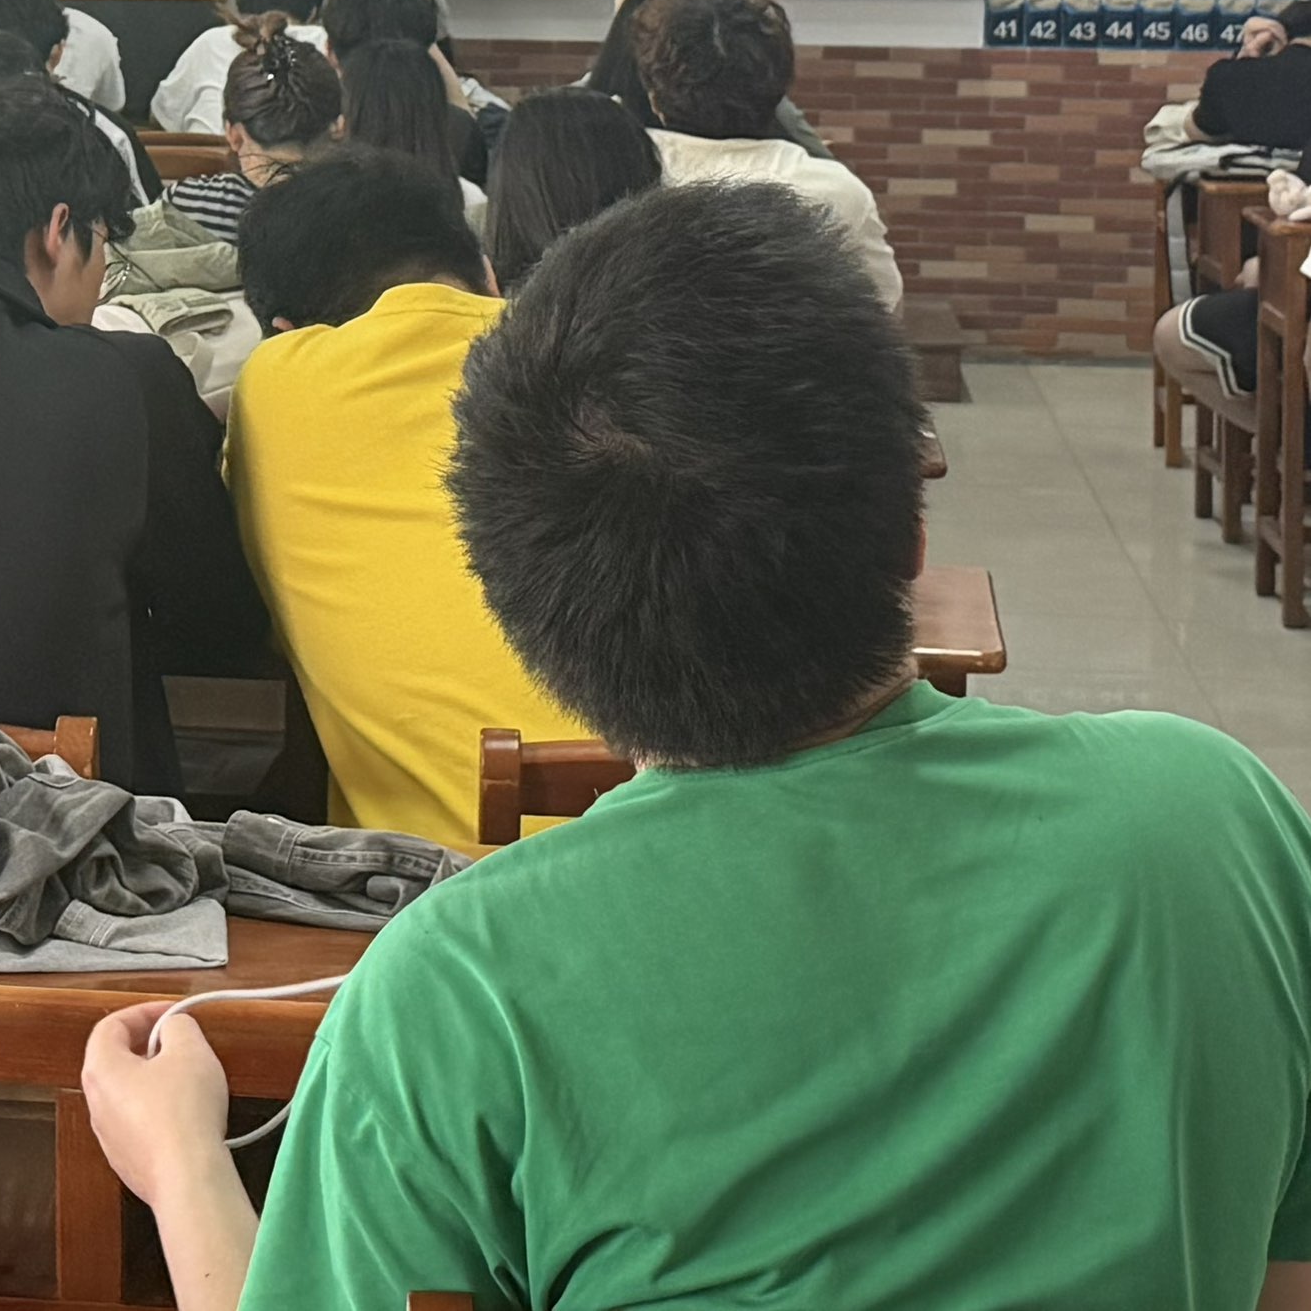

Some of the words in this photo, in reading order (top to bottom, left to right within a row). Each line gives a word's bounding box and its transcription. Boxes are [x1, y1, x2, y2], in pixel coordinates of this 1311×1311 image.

[993, 19, 1017, 38] 41
[1029, 20, 1057, 39] 42
[1069, 21, 1096, 41] 43
[1105, 21, 1133, 39] 44
[1143, 21, 1171, 40] 45
[1180, 23, 1209, 42] 46
